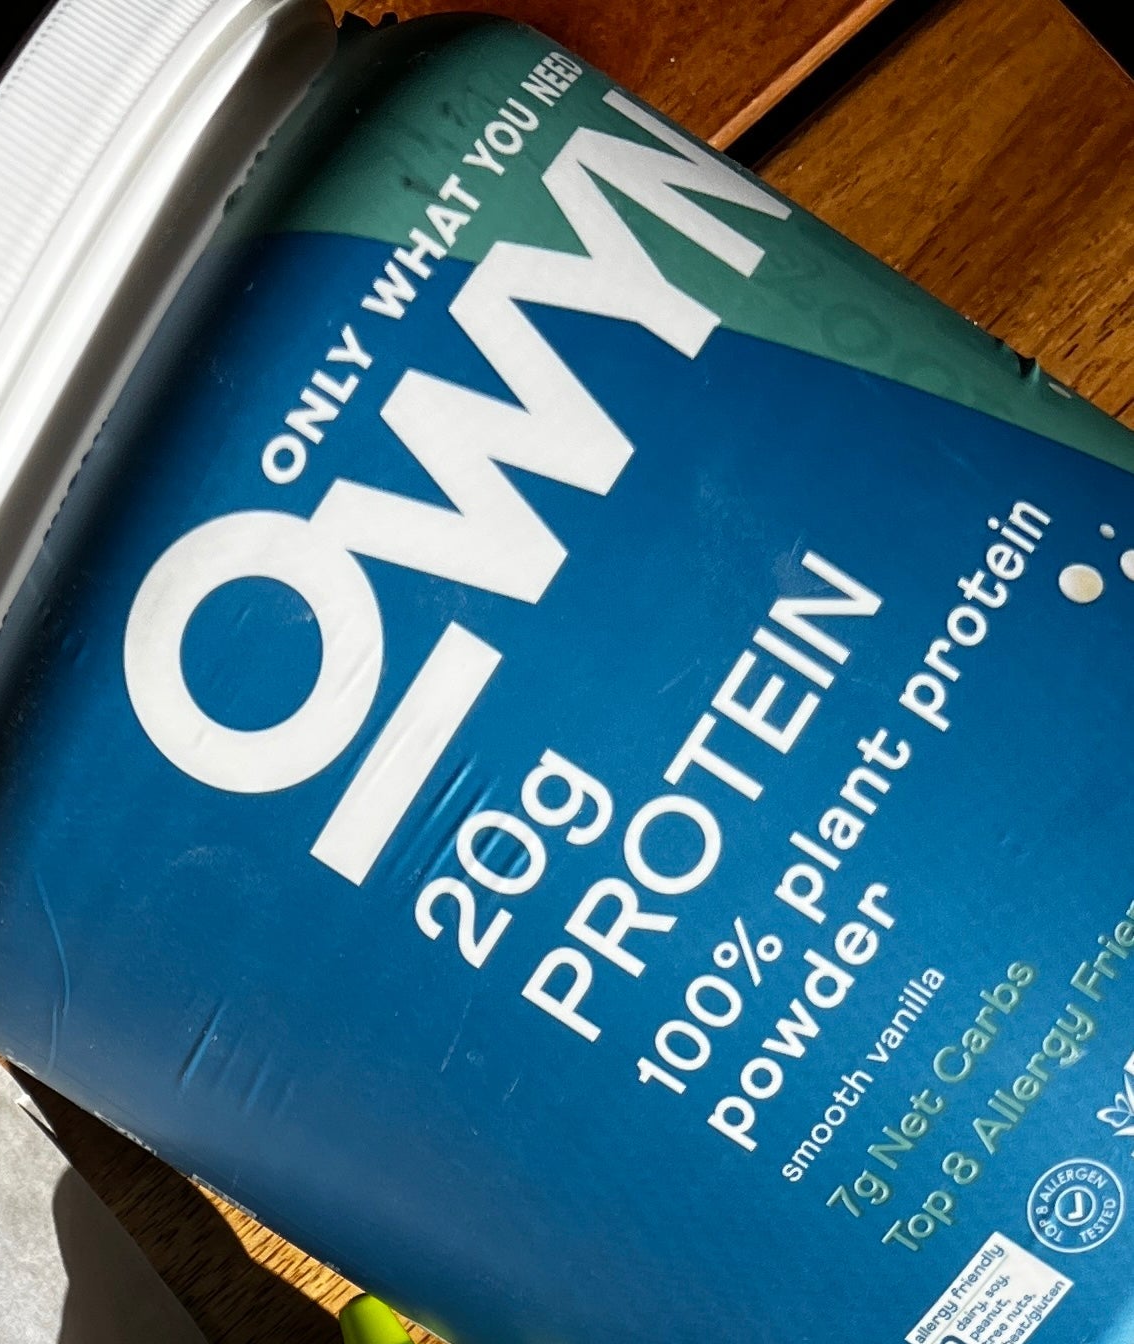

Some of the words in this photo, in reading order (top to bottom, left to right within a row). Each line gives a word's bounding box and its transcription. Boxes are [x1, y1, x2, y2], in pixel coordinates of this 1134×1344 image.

[261, 323, 373, 485] ONLY
[361, 173, 481, 320] WHAT
[462, 97, 540, 177] YOU
[520, 51, 584, 107] NEED
[124, 88, 792, 794] OWYN
[415, 748, 614, 969] 20g
[522, 549, 883, 1043] PROTEIN
[637, 915, 783, 1096] 100%
[773, 727, 912, 926] plant
[897, 499, 1052, 732] protein
[706, 882, 900, 1153] powder
[781, 1069, 874, 1183] smooth
[866, 967, 945, 1064] vanilla
[825, 1170, 890, 1219] 7g
[867, 1089, 946, 1171] Net
[932, 960, 1035, 1083] Carbs
[881, 1189, 955, 1252] Top
[941, 1151, 980, 1186] 8
[972, 1004, 1097, 1155] Allergy
[1070, 900, 1134, 1002] Frie
[915, 1300, 958, 1344] allergy
[950, 1244, 1005, 1299] friendly
[1039, 1167, 1108, 1203] ALLERGEN
[1078, 1198, 1116, 1243] TESTED
